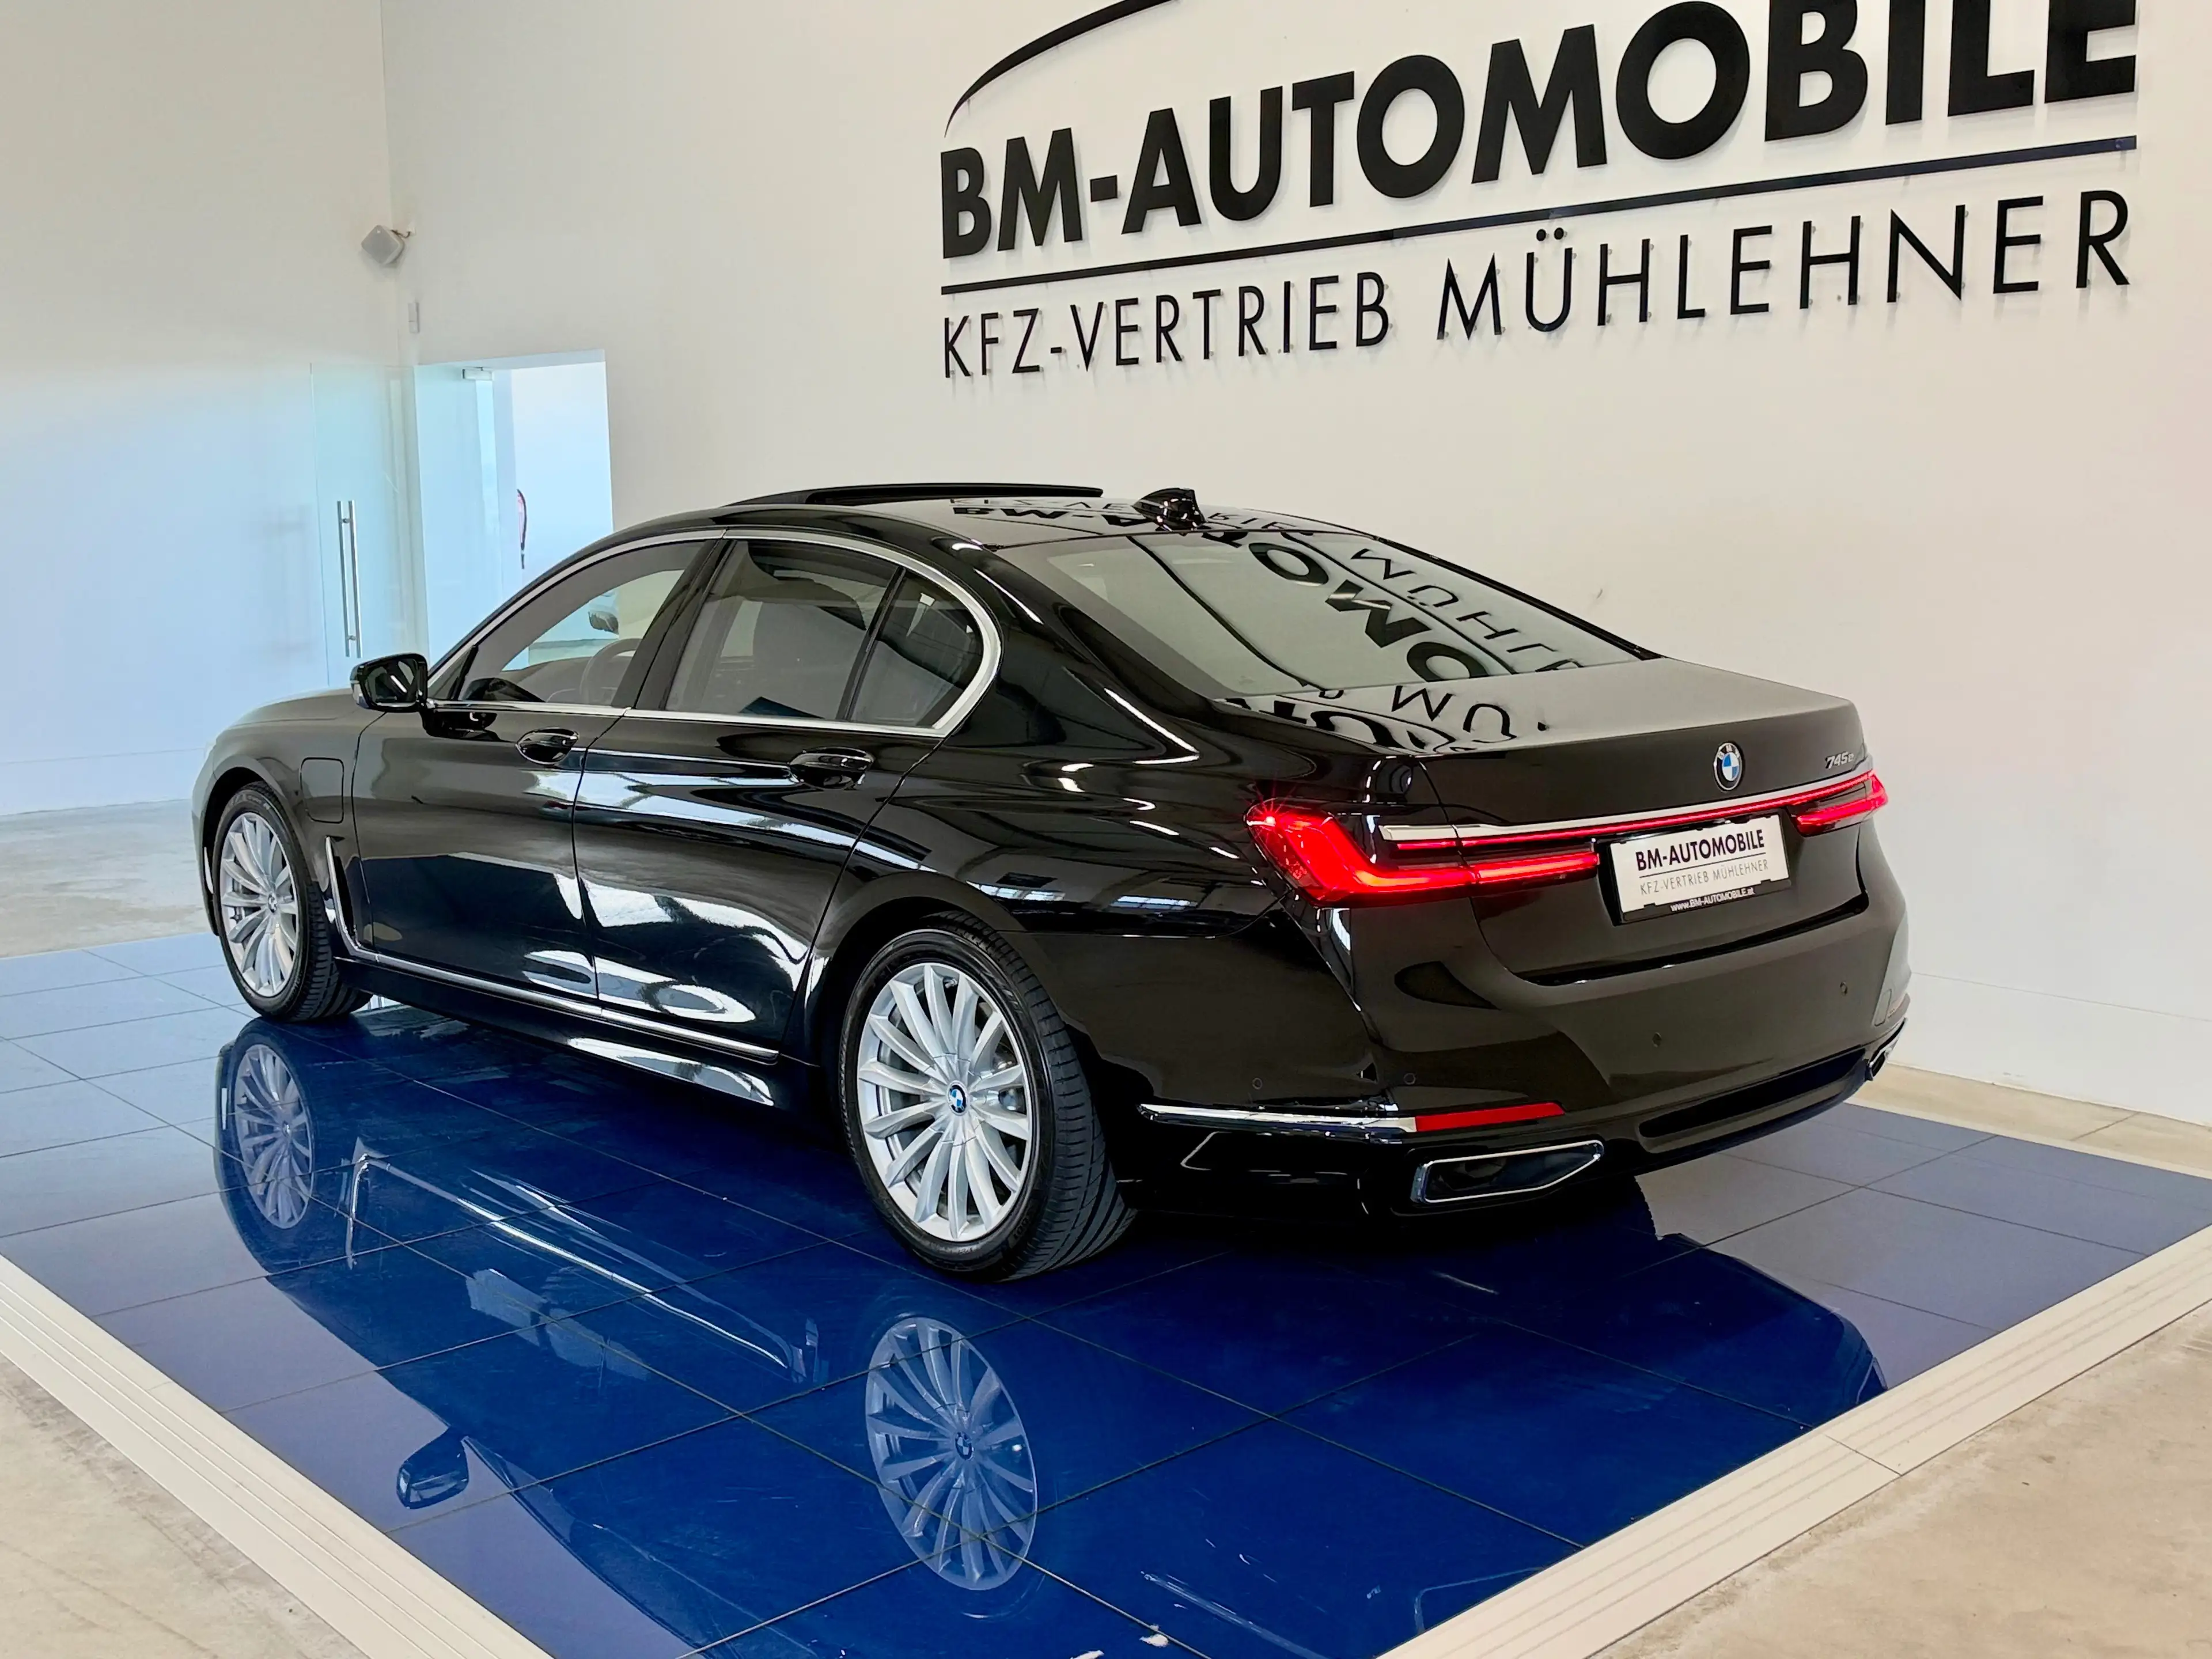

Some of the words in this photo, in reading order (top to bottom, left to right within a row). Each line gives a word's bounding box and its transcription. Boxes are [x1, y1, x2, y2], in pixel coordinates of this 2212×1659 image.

[940, 0, 2136, 259] BM-AUTOMOBILE
[944, 271, 1390, 378] KFZ-VERTRIEB
[1436, 190, 2130, 340] MÜHLEHNER
[1635, 830, 1764, 871] BM-AUTOMOBILE
[1640, 872, 1709, 895] KFZ-VERTRIEB
[1713, 859, 1768, 881] MÜHLEHNER
